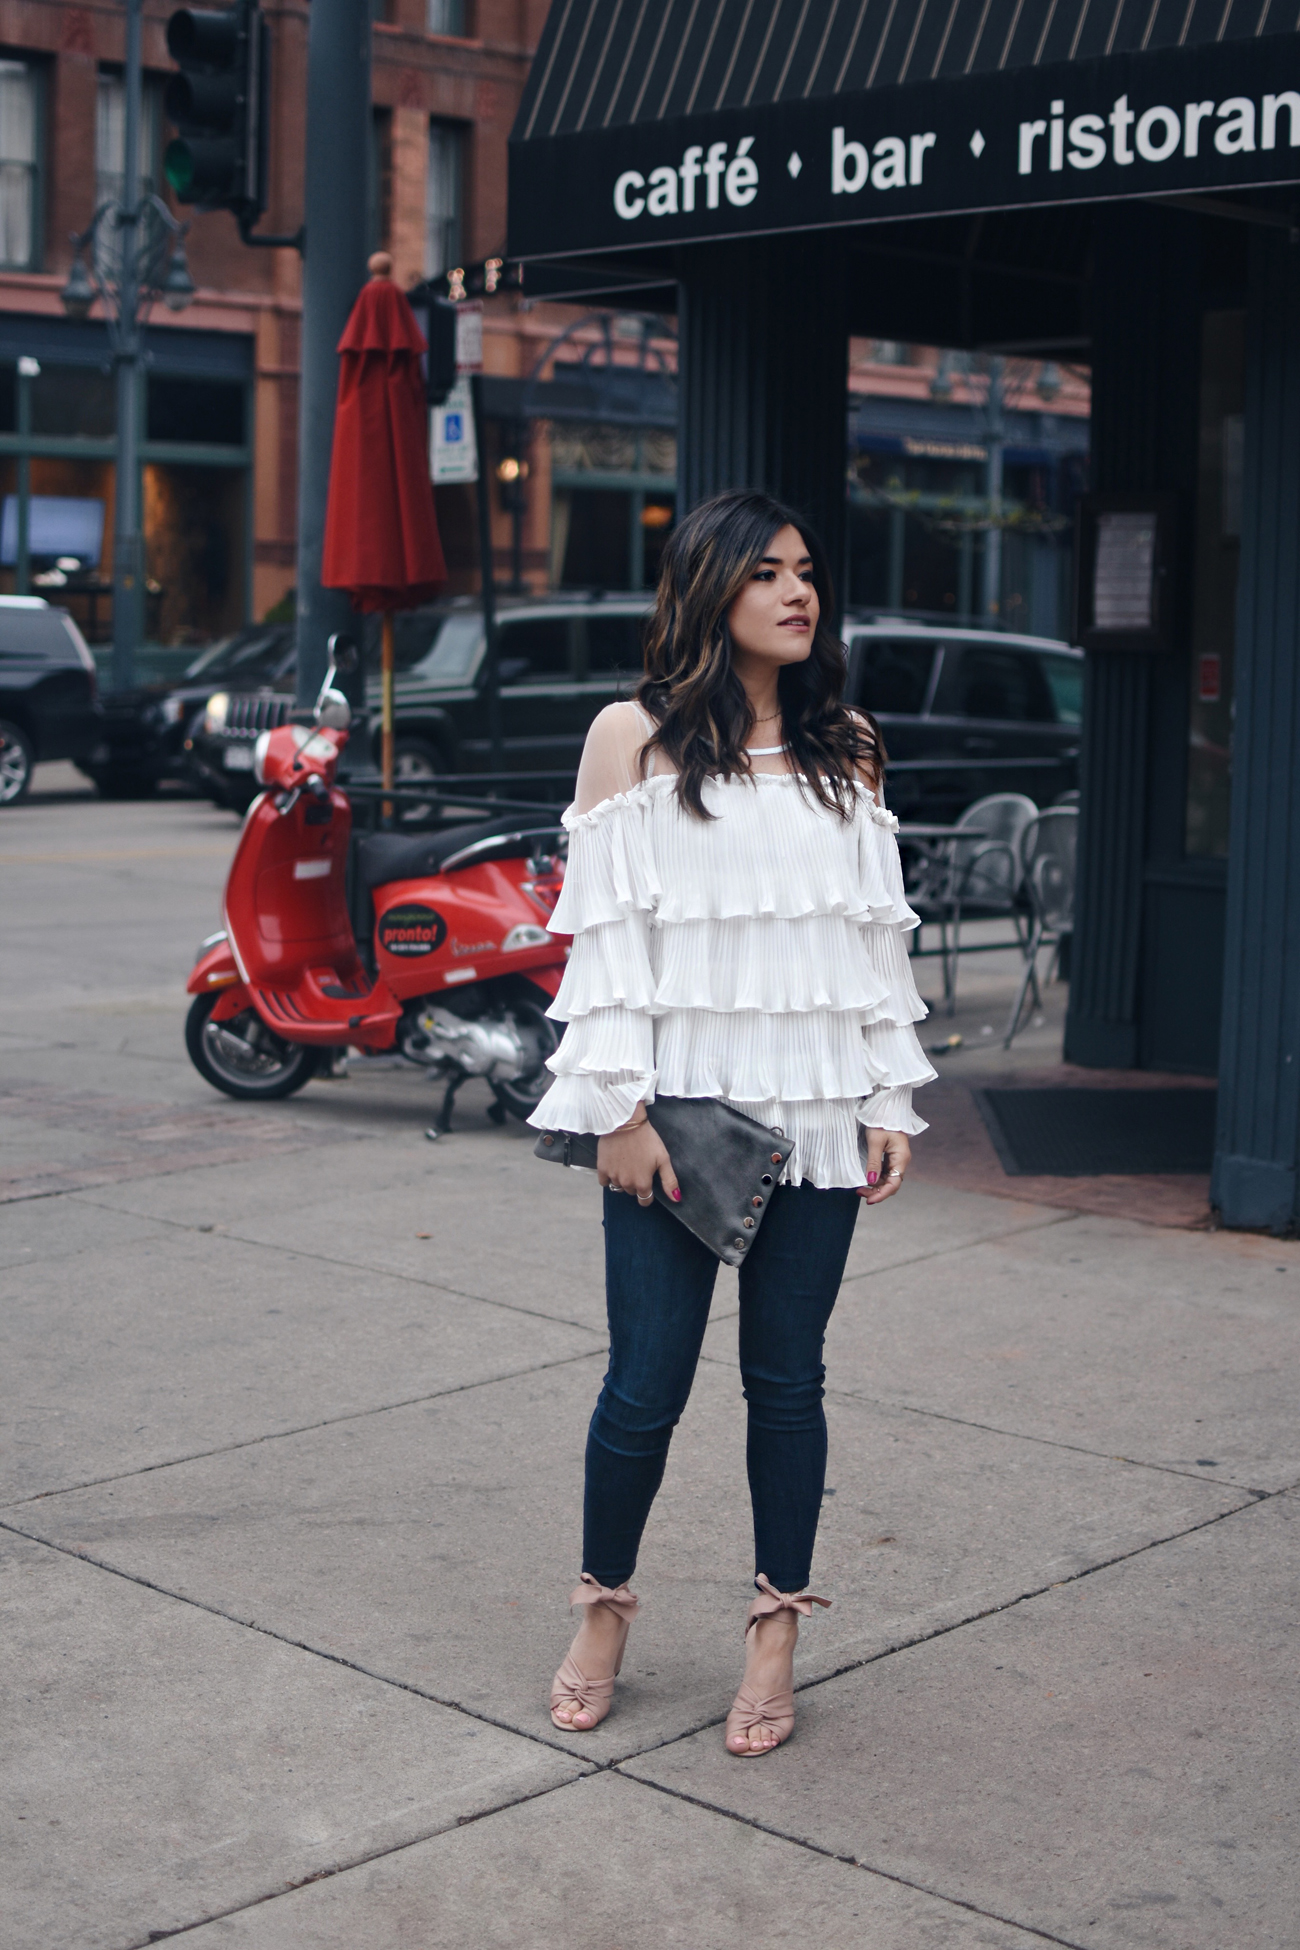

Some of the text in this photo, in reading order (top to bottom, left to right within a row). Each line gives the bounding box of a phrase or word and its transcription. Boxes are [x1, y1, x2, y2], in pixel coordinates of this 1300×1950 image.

[613, 90, 1300, 220] caffé bar ristoran
[384, 924, 438, 946] pronto!
